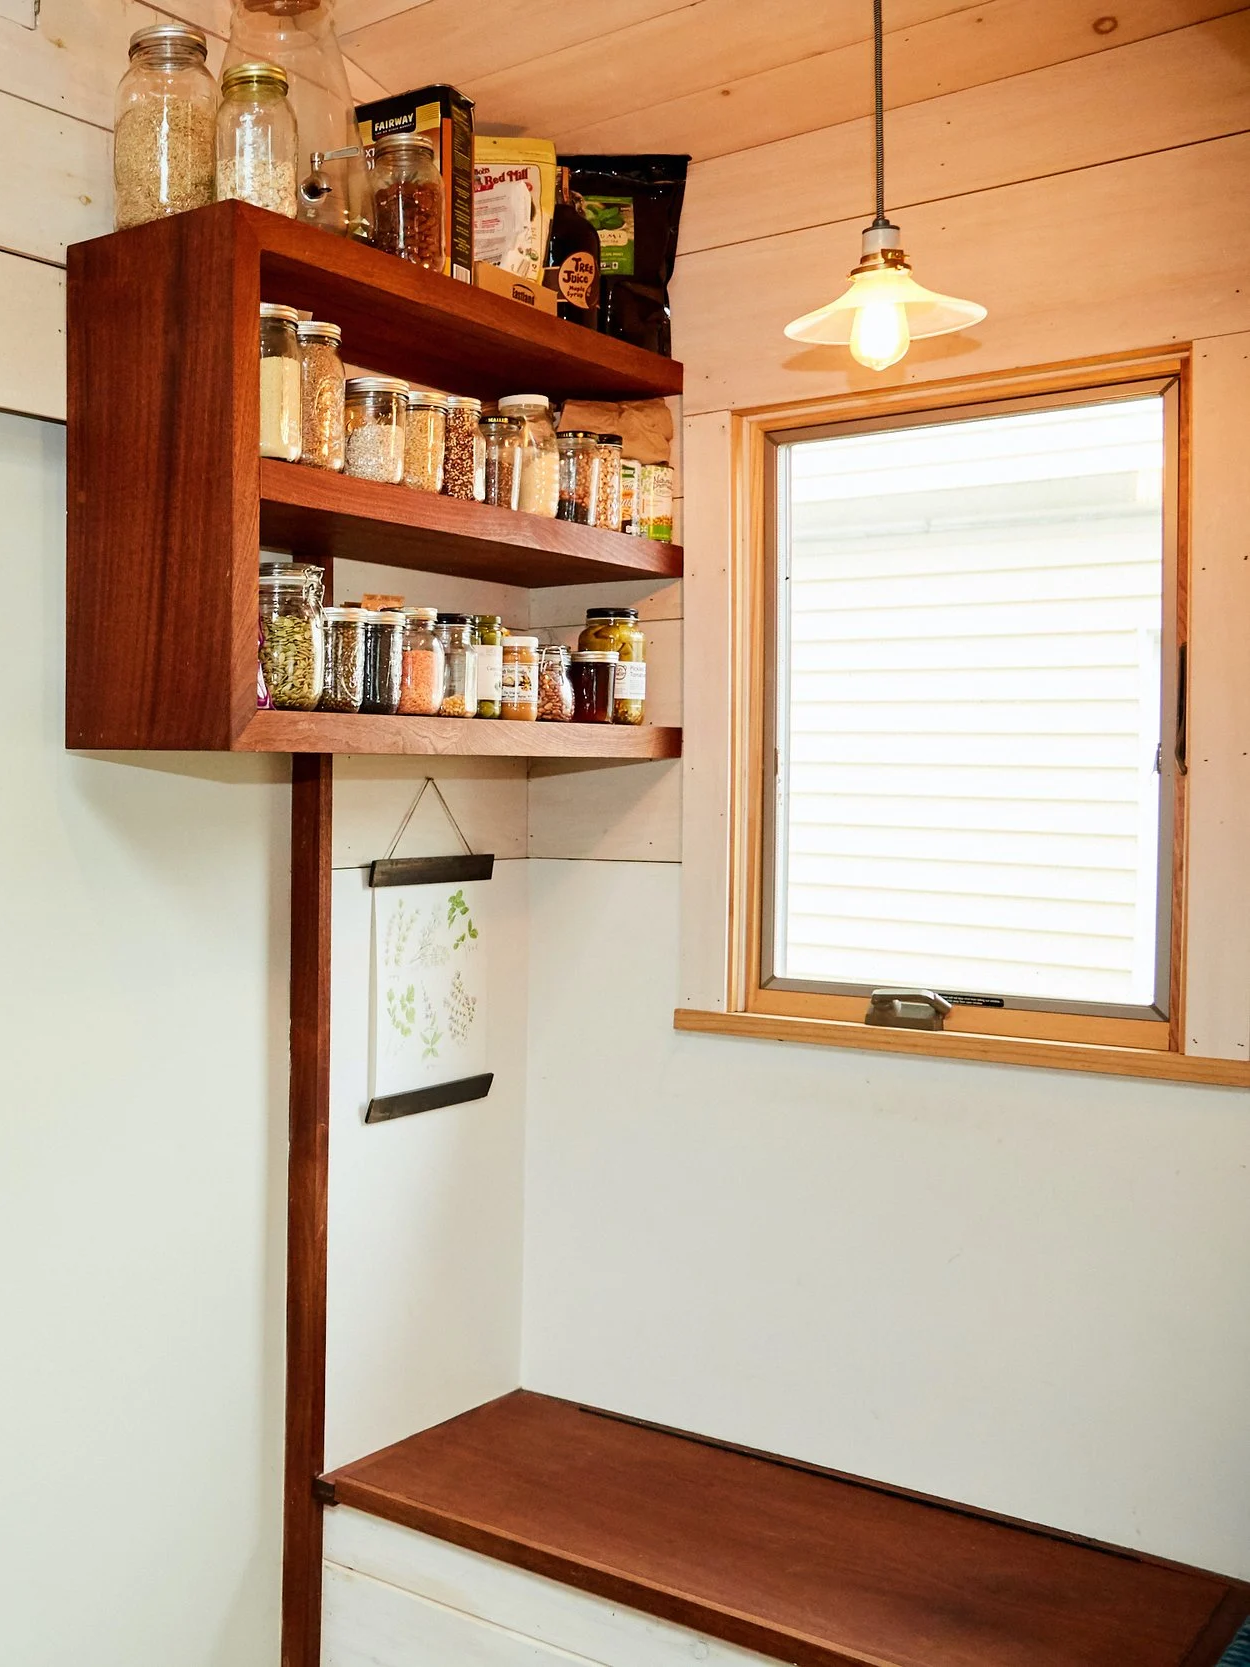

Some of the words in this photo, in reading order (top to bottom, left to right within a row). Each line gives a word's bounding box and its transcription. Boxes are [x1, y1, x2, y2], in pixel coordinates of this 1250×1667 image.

[374, 113, 414, 131] FAIRWAY
[484, 172, 506, 184] Red
[506, 168, 529, 182] Mill
